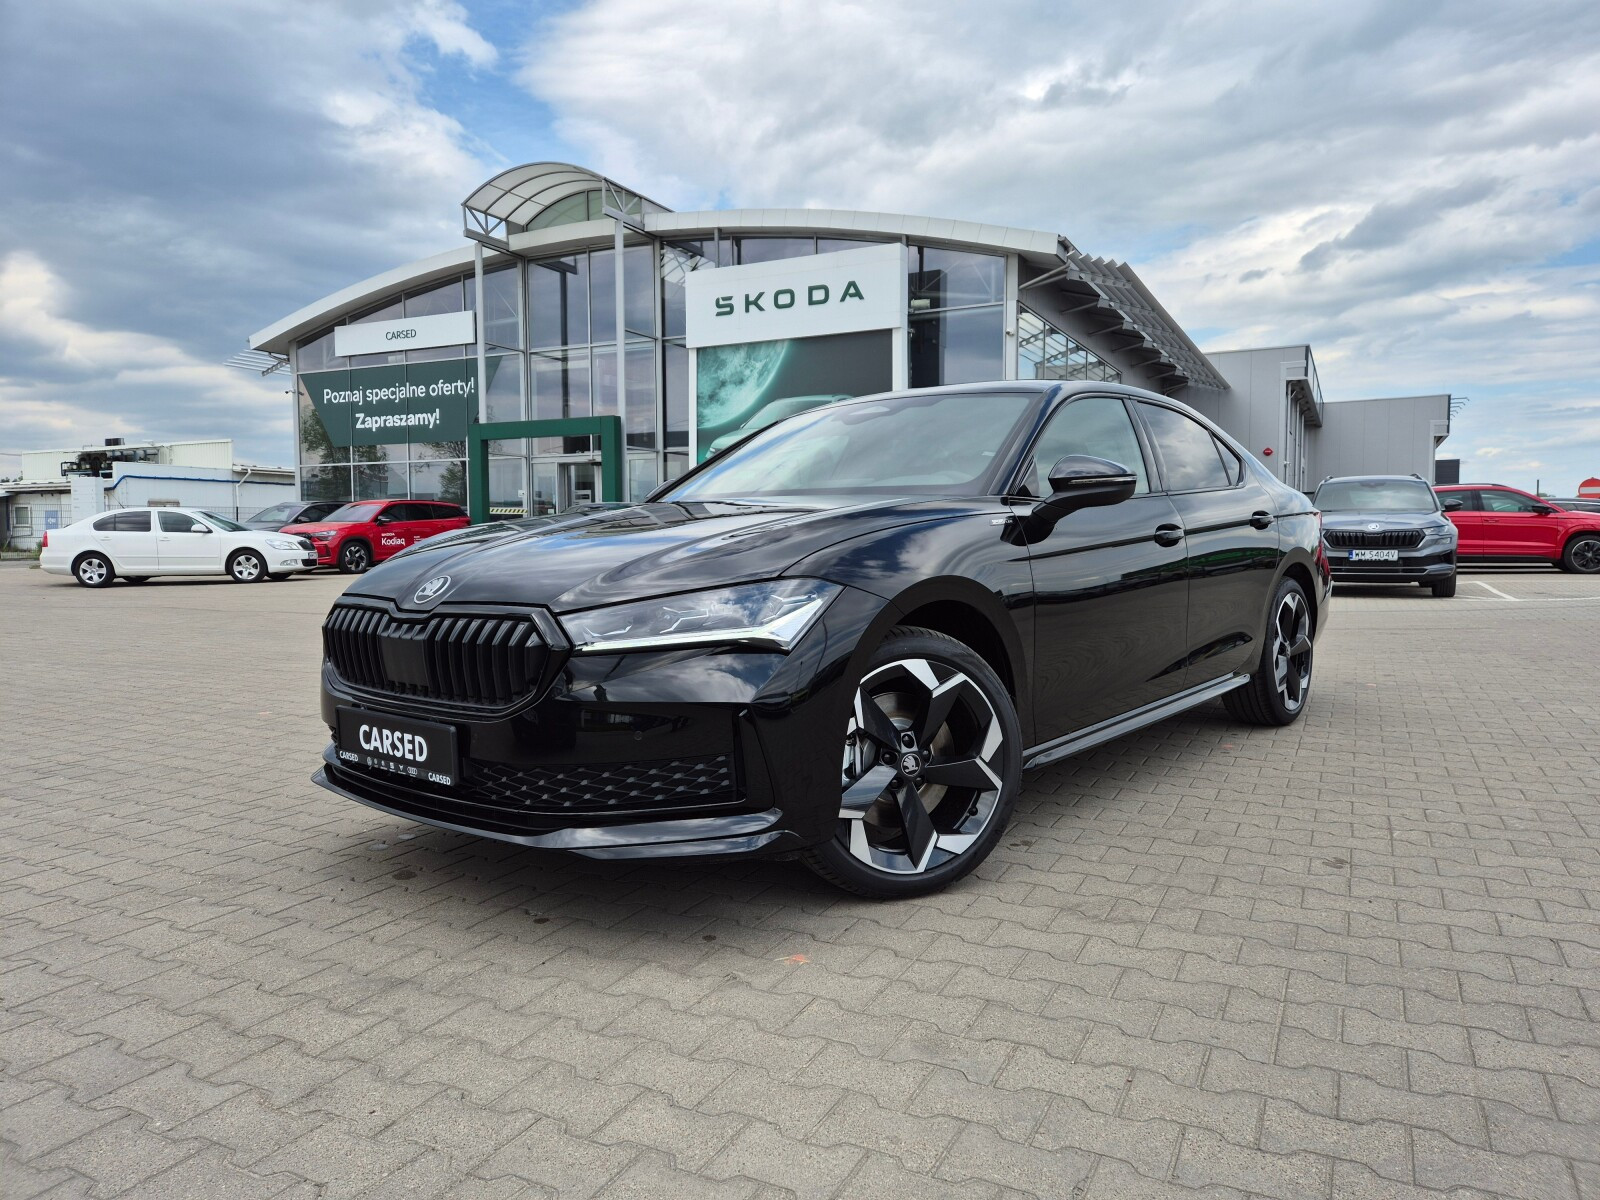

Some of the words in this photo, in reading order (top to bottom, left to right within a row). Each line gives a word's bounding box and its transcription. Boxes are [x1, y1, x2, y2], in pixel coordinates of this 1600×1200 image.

[385, 329, 417, 341] CARSED
[323, 386, 363, 405] Poznaj
[366, 382, 426, 404] specjalne
[429, 377, 475, 397] oferty!
[355, 408, 440, 432] Zapraszamy!
[381, 537, 406, 546] Kodiaq
[1369, 550, 1396, 559] 5404V
[359, 724, 428, 762] CARSED
[339, 750, 359, 762] CARSED
[427, 772, 451, 786] CARSED
